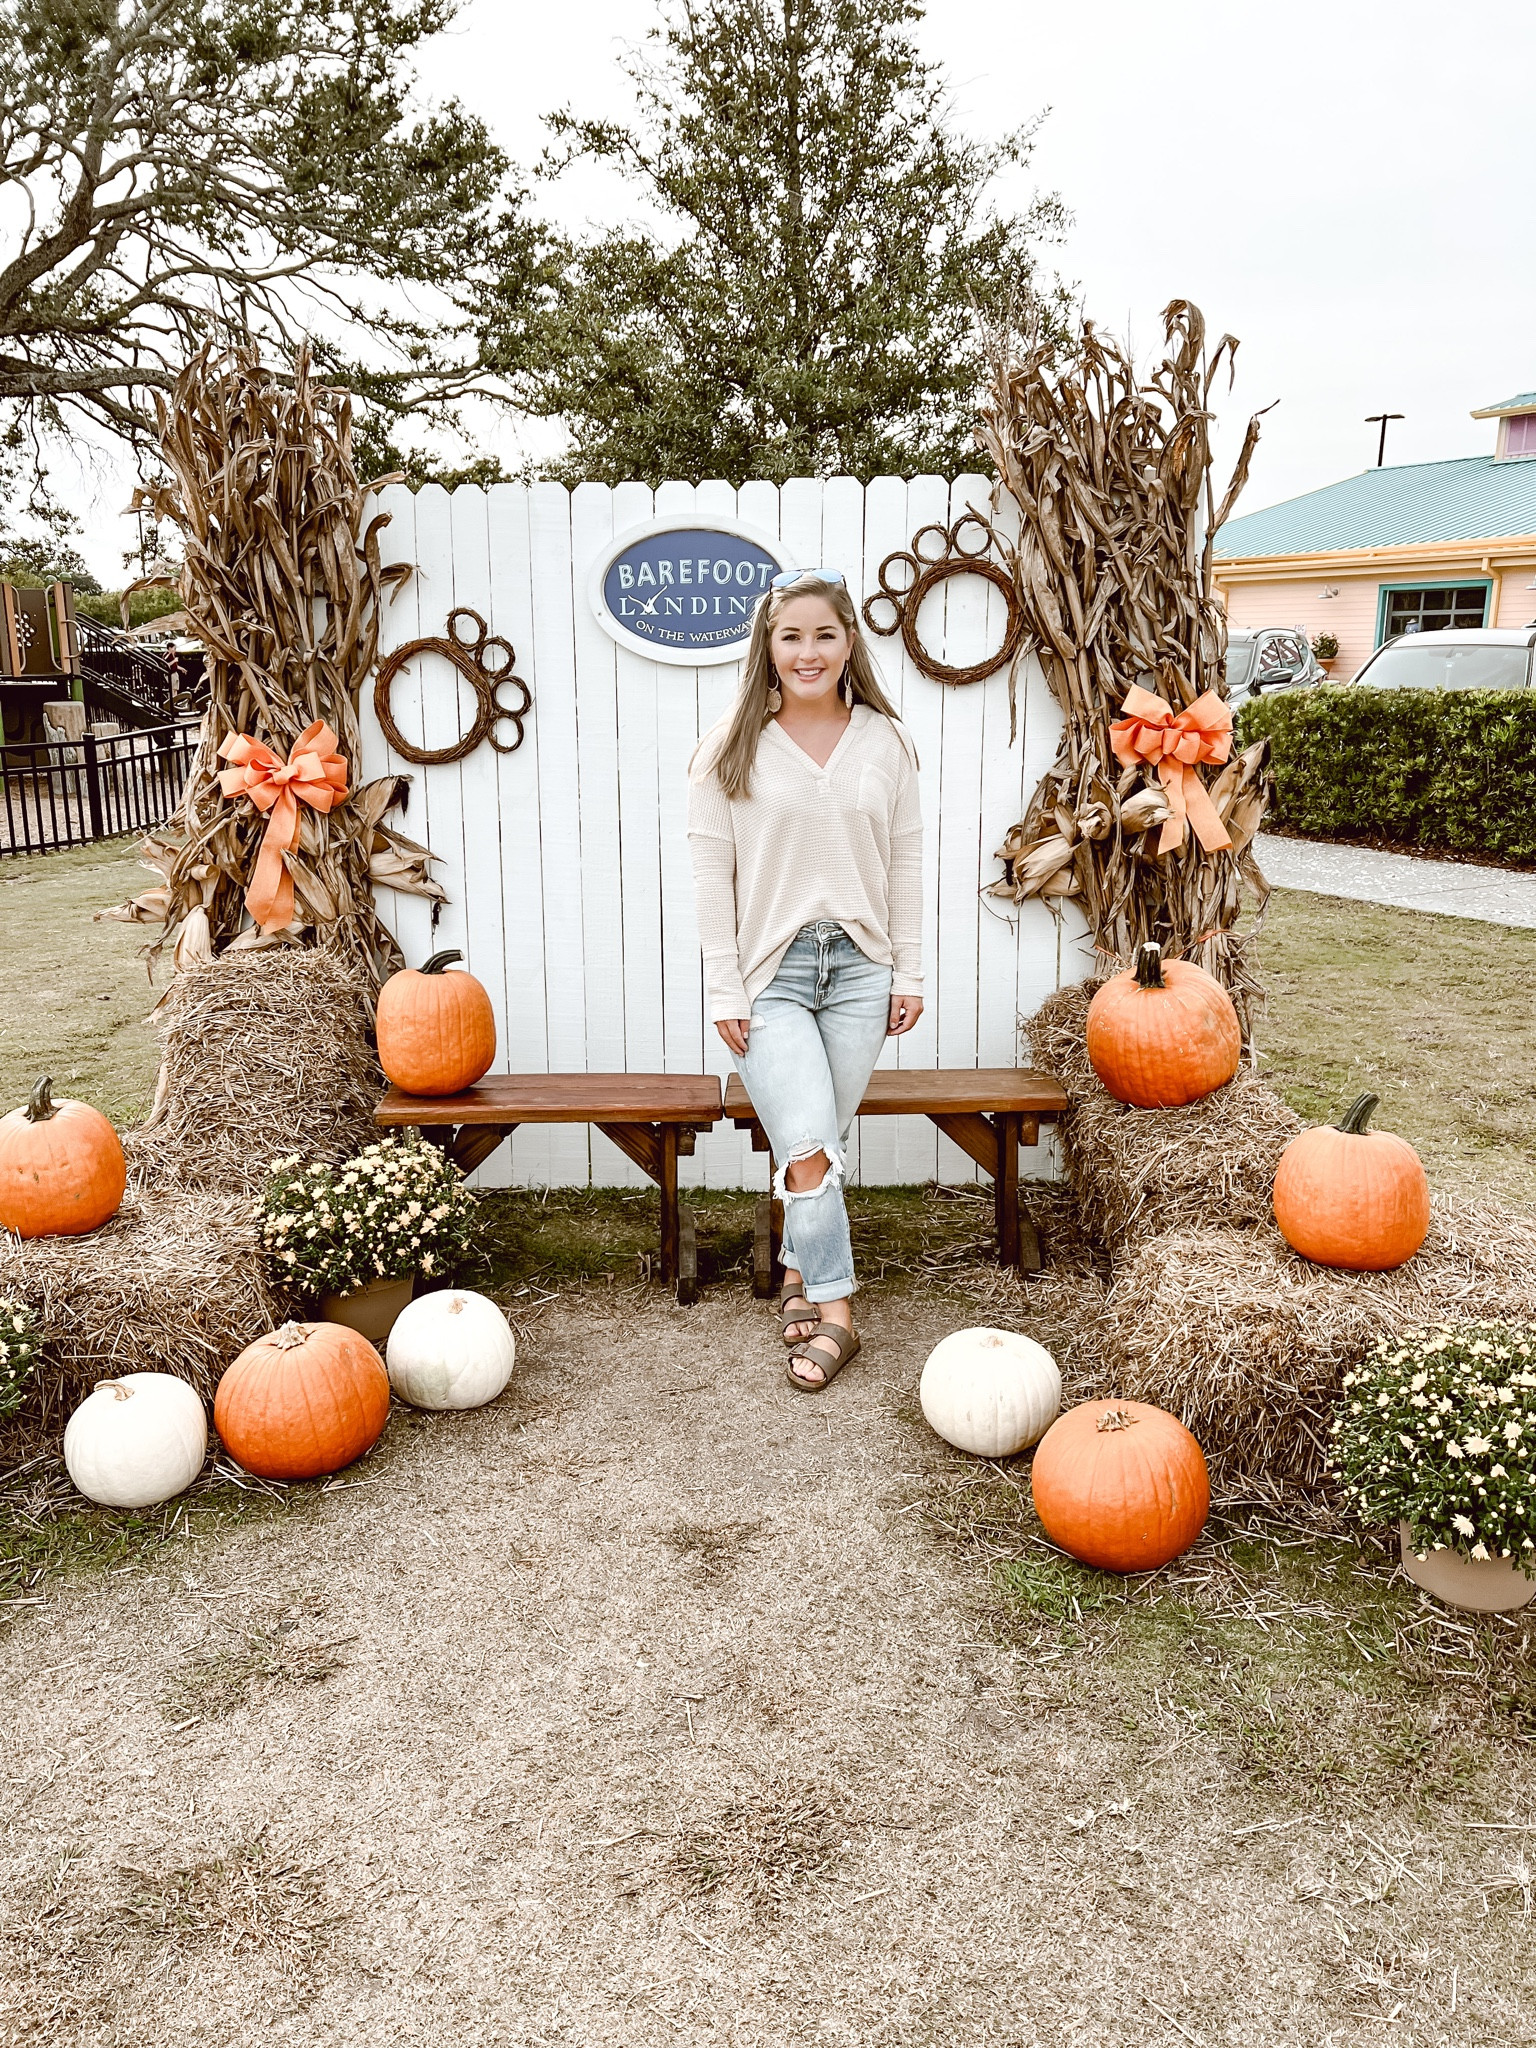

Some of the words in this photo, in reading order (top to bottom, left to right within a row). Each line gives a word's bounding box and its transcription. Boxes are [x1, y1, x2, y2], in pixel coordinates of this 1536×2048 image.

[618, 559, 773, 589] BAREFOOT
[619, 594, 758, 616] LANDIN
[636, 620, 655, 634] ON
[658, 628, 685, 641] THE
